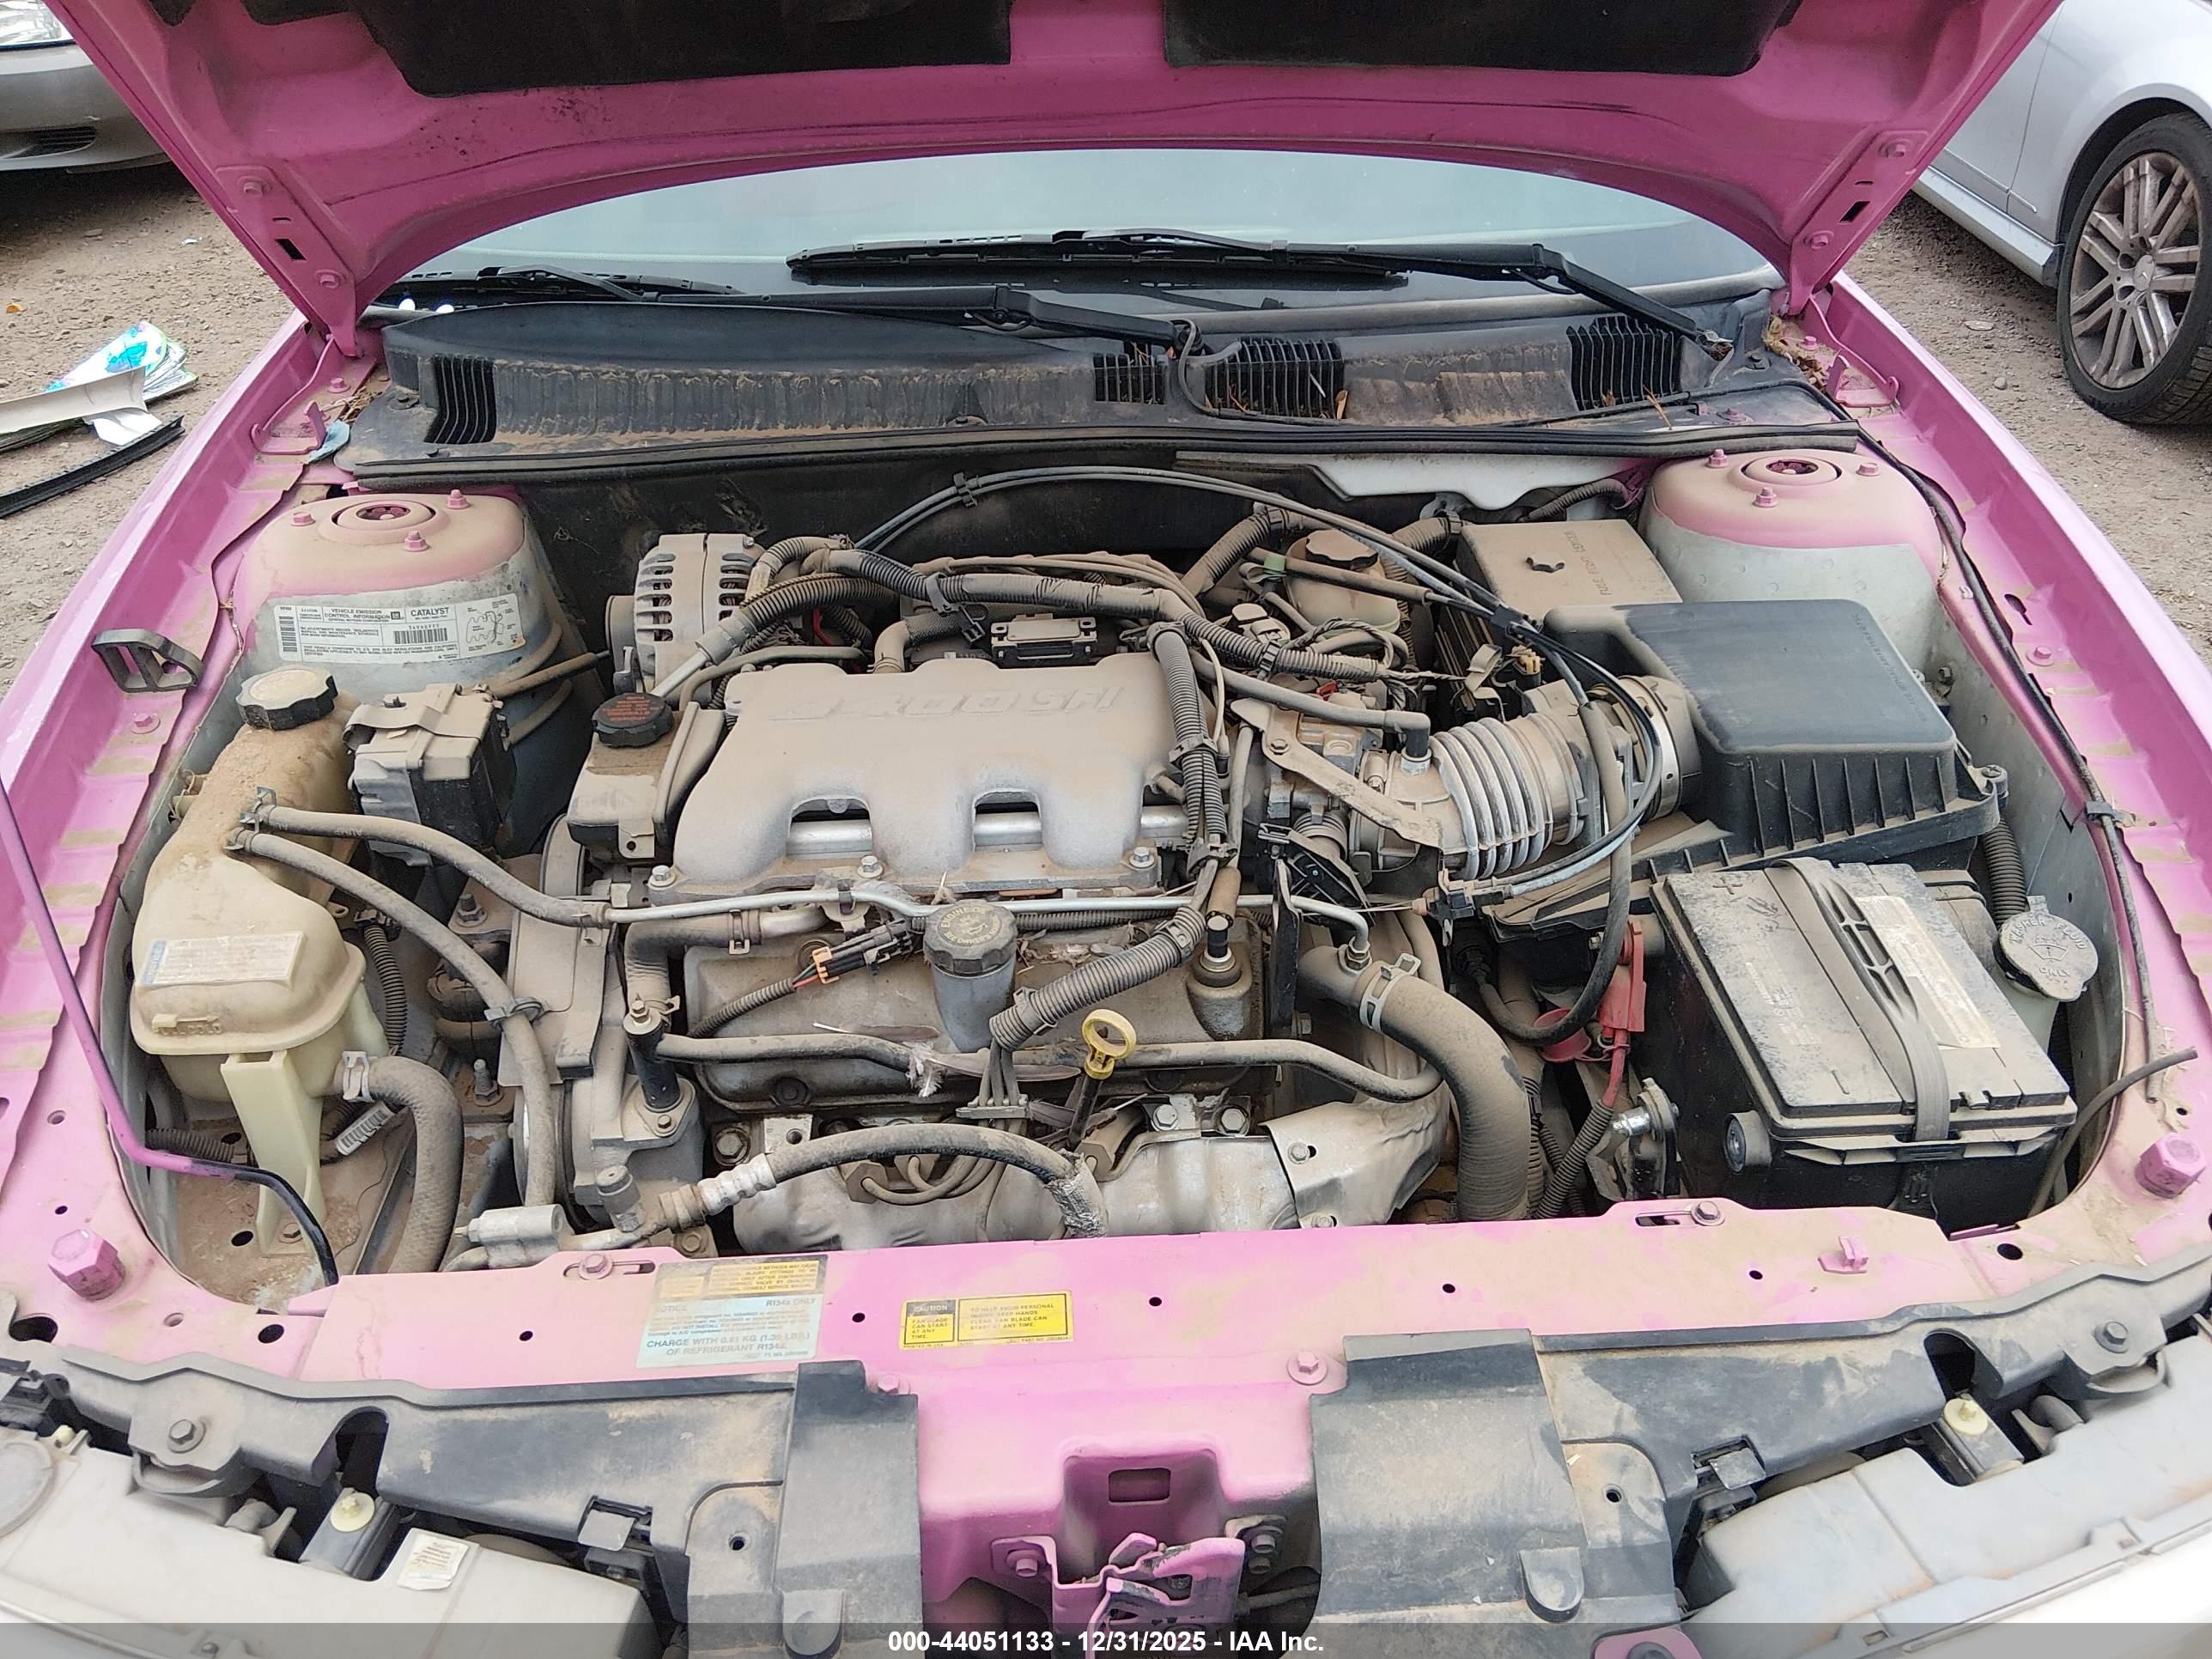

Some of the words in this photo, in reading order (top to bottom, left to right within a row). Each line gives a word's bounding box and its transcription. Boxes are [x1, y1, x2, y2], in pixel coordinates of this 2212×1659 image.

[410, 606, 449, 617] CATALYST
[1024, 685, 1126, 716] SFI
[2008, 914, 2047, 943] WASHER
[2055, 921, 2089, 950] FLUID
[2039, 965, 2071, 978] ONLY
[913, 1304, 949, 1313] CAUTION
[647, 1339, 690, 1348] CHARGE
[692, 1337, 720, 1346] WITH
[742, 1334, 757, 1343] KG
[666, 1347, 682, 1356] OF
[683, 1343, 755, 1355] REFRIGERANT
